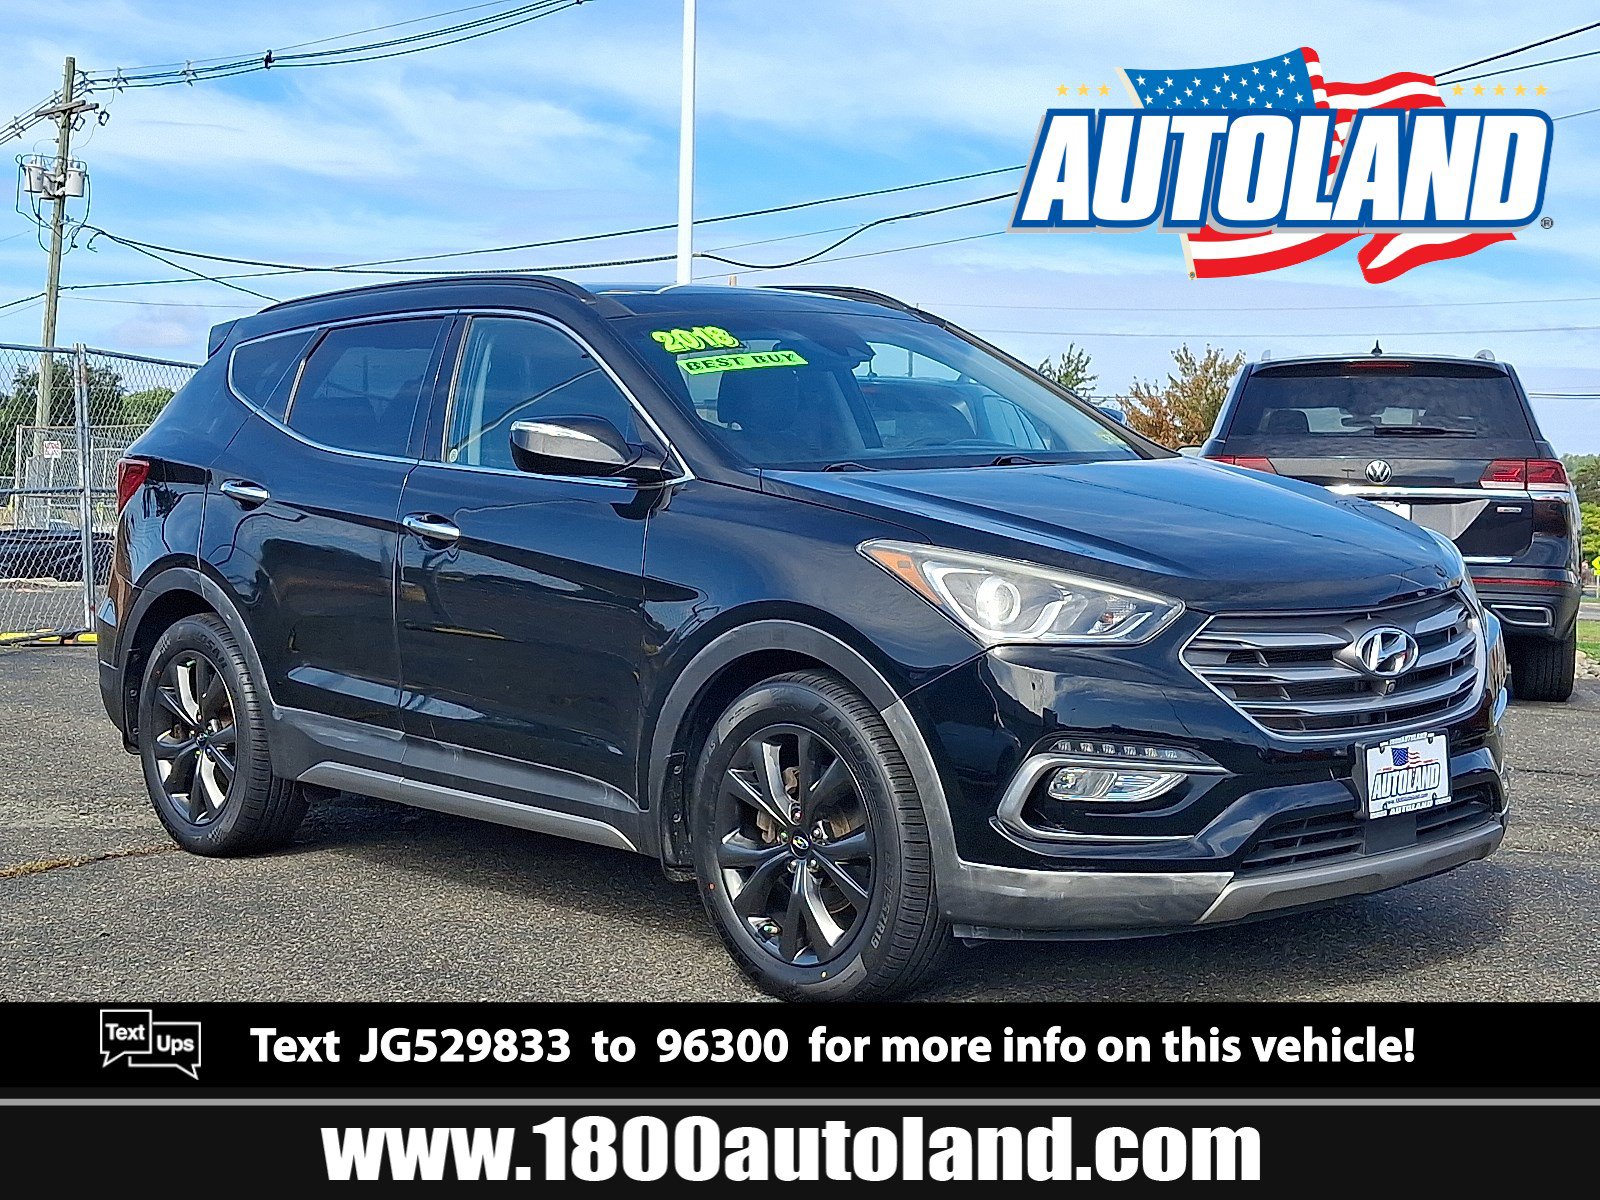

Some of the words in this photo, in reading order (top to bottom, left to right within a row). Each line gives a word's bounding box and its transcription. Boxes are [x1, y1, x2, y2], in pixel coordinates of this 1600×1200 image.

[652, 326, 740, 353] 2018
[686, 356, 745, 371] BEST
[752, 353, 797, 365] BUY
[1371, 762, 1441, 801] AUTOLAND
